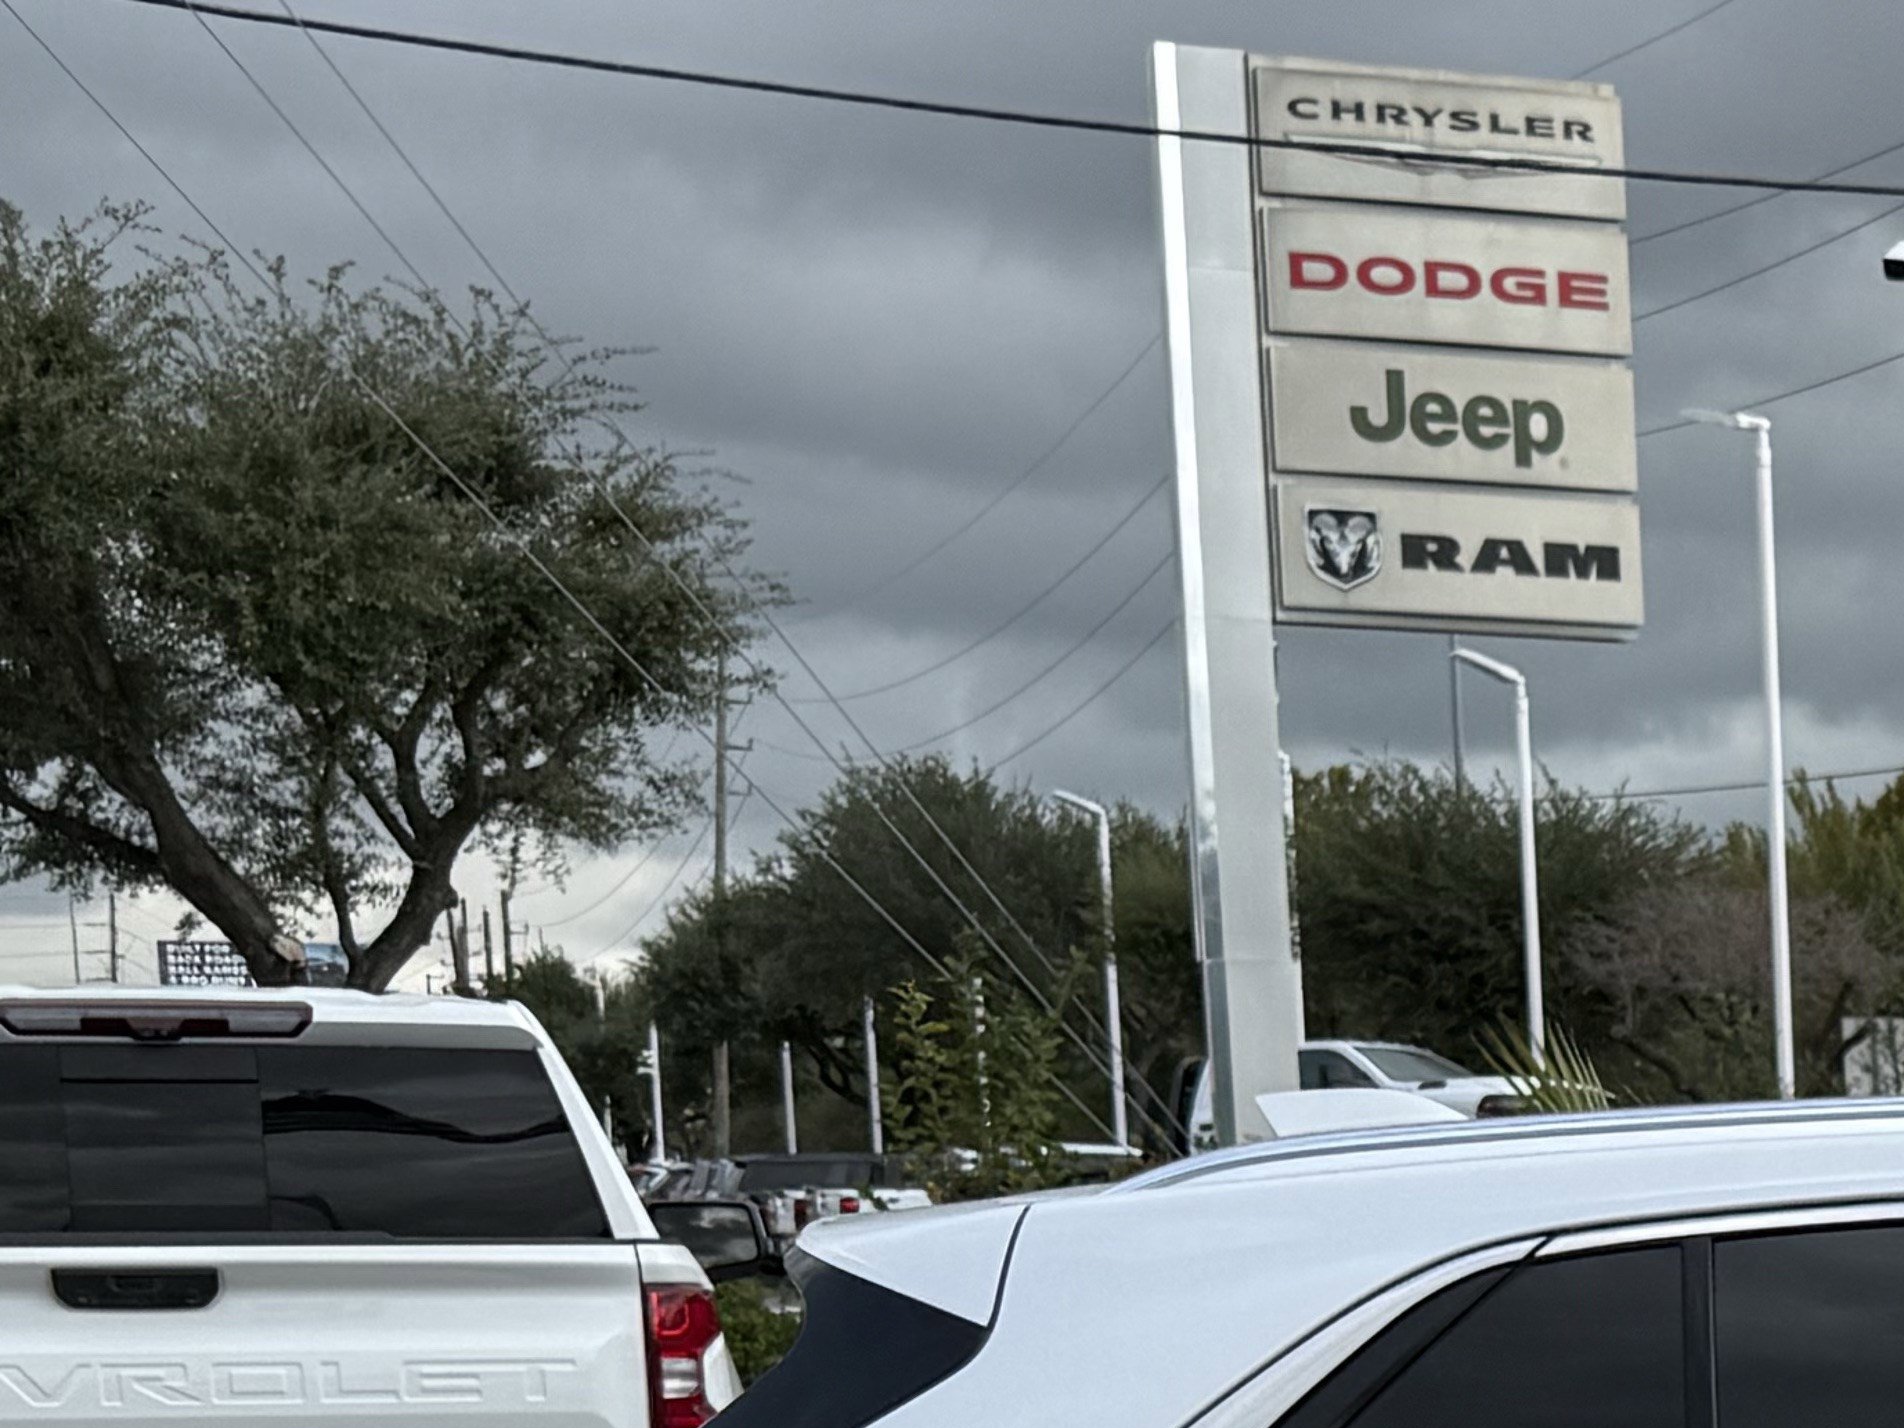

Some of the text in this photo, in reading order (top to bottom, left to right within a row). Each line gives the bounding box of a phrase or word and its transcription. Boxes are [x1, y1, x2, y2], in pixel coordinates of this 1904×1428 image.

[1287, 98, 1596, 143] CHRYSLER
[1287, 251, 1610, 312] DODGE
[1349, 369, 1564, 468] Jeep
[1400, 533, 1622, 582] RAM
